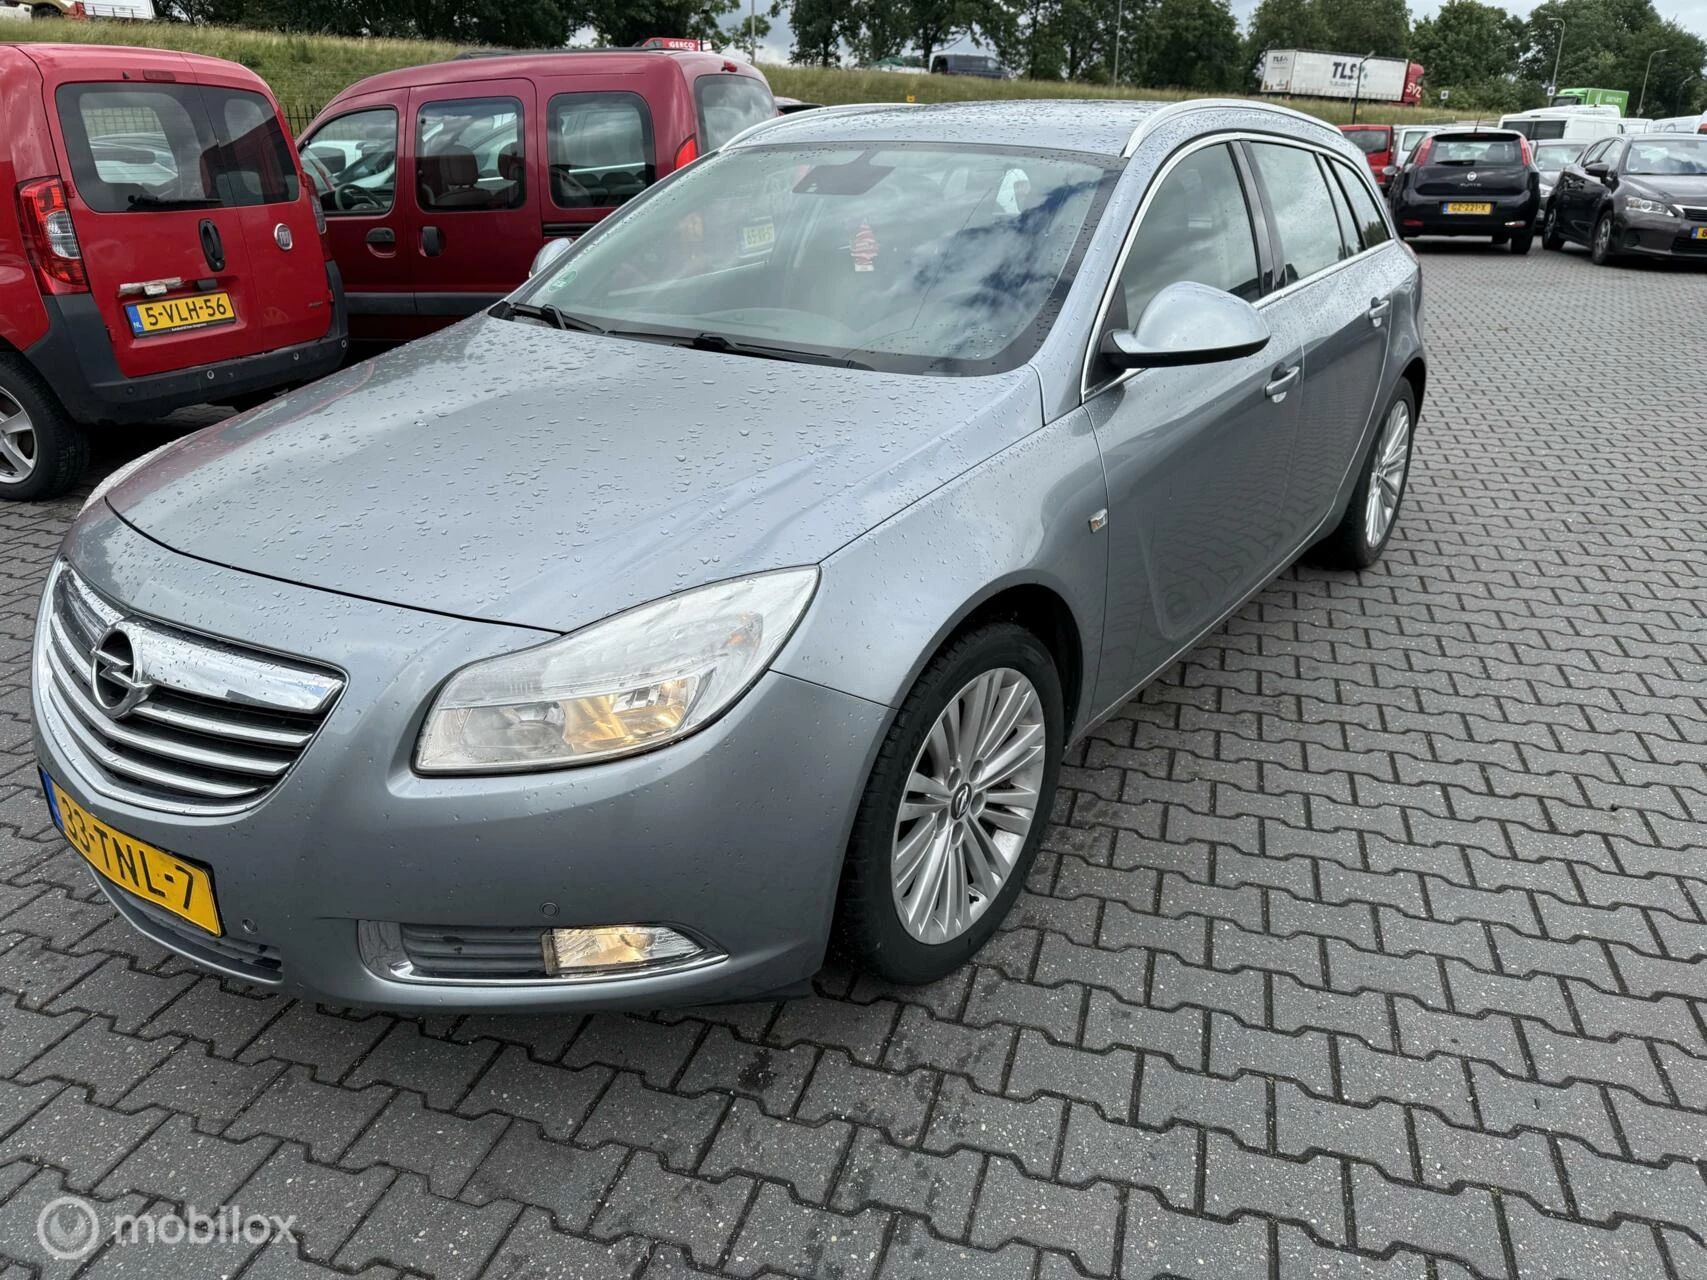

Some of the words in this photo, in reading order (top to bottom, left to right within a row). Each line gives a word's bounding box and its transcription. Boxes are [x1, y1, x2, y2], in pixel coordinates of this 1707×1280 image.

[1332, 62, 1357, 80] TLS
[144, 297, 227, 326] 5-VLH-56
[61, 797, 194, 910] 33-TNL-7
